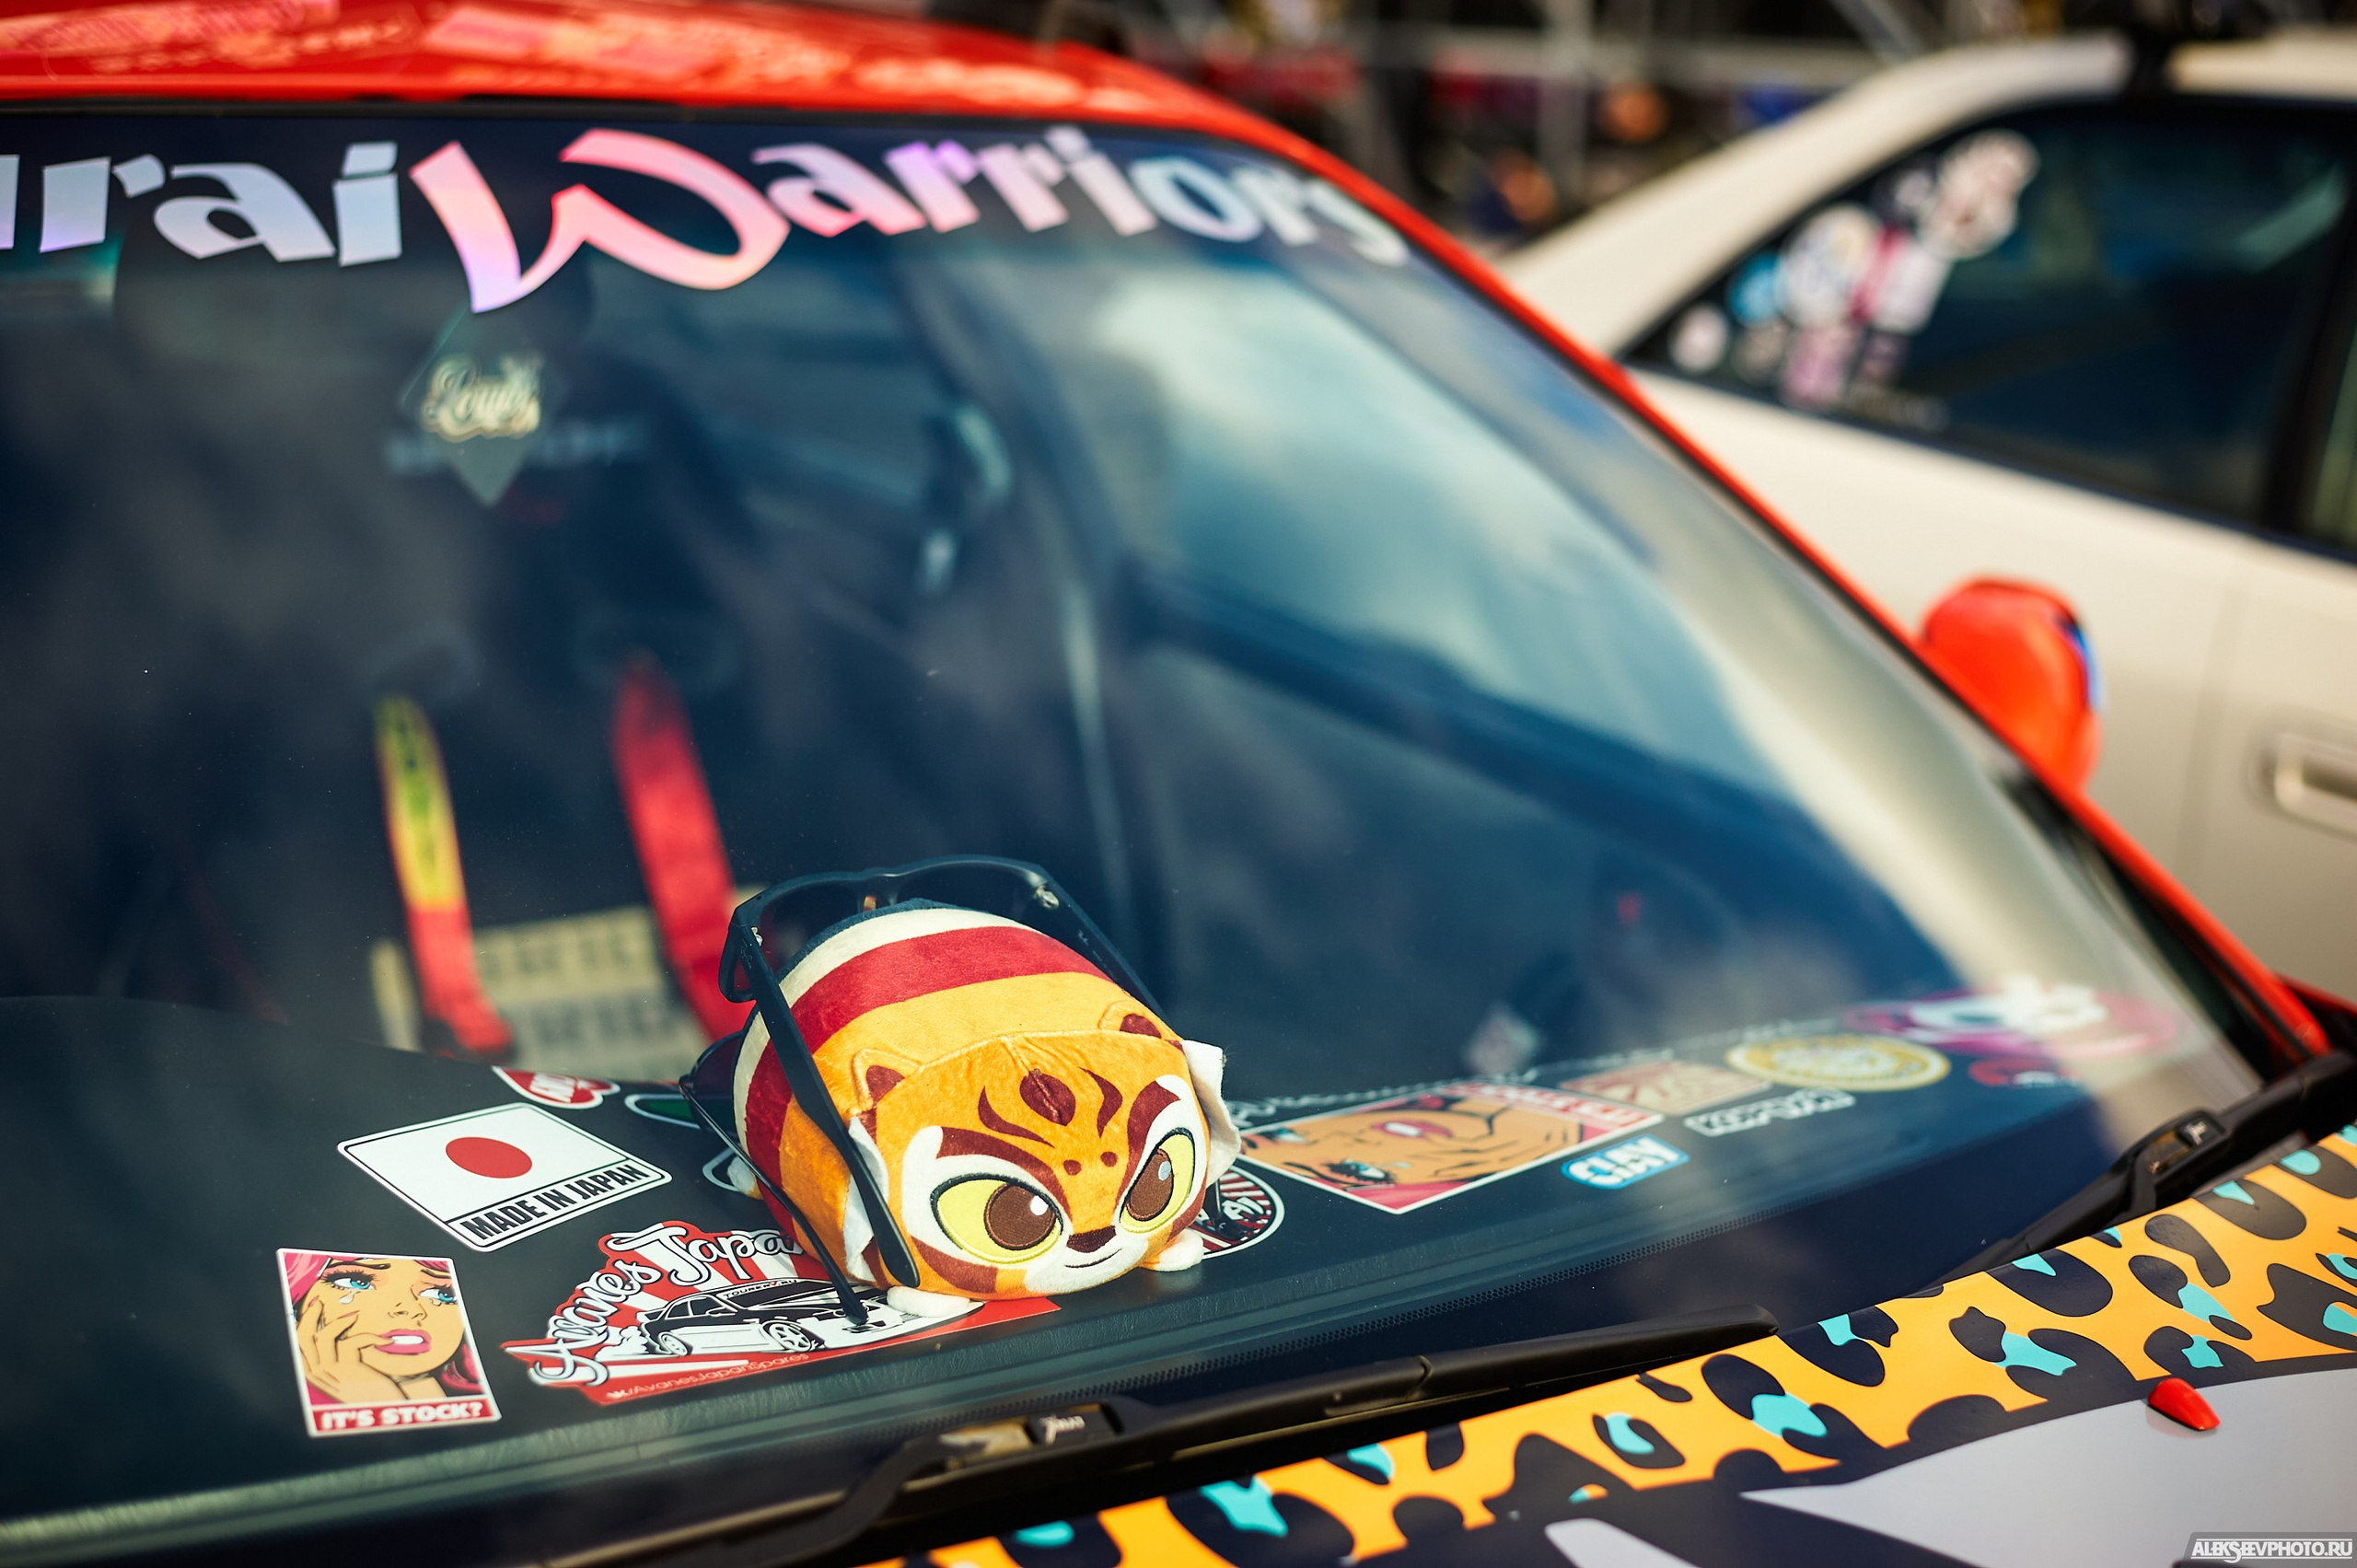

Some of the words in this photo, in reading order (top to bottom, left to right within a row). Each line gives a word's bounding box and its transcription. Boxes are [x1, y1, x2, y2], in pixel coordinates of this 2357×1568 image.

[410, 126, 1410, 313] Warriors
[460, 1200, 549, 1239] MADE
[532, 1189, 577, 1211] IN
[563, 1164, 650, 1200] JAPAN
[607, 1225, 805, 1282] Japa
[322, 1410, 375, 1430] IT'S
[381, 1401, 483, 1424] STOCK?
